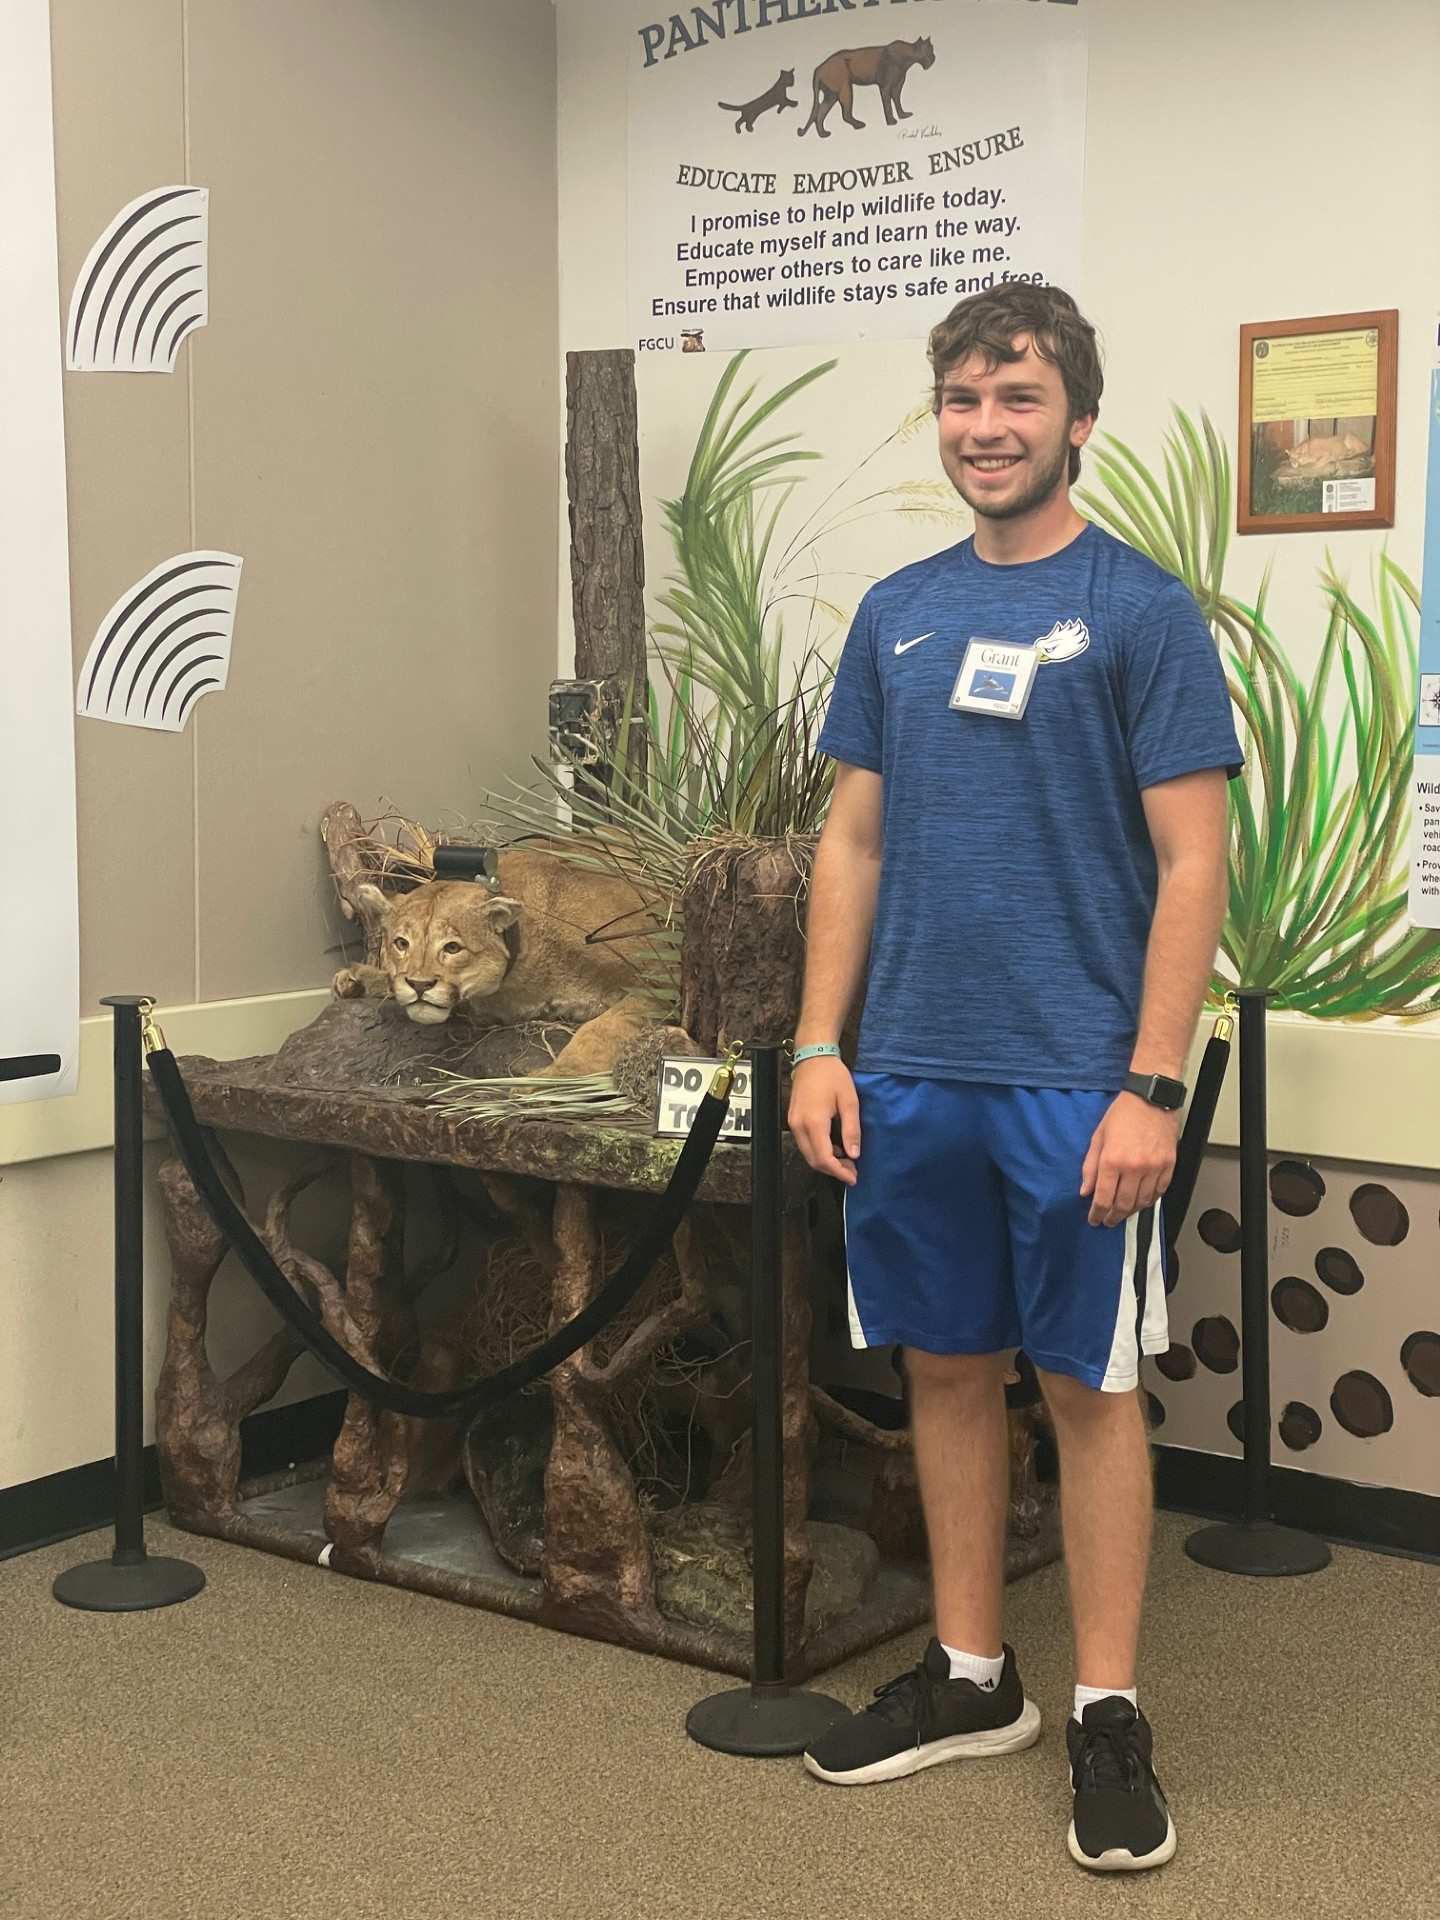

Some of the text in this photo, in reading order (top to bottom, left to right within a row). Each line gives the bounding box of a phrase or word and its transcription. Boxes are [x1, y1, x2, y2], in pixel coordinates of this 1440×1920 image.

[676, 164, 777, 194] EDUCATE
[792, 161, 914, 194] EMPOWER
[928, 126, 1024, 175] ENSURE
[691, 187, 1006, 237] I promise to help wildlife today.
[677, 216, 1021, 261] Educate myself and learn the way.
[685, 246, 1011, 289] Empower others to care like me.
[652, 298, 717, 316] Ensure
[723, 291, 760, 311] that
[766, 286, 836, 307] wildlife
[843, 283, 898, 305] stays
[904, 277, 948, 298] safe
[954, 272, 994, 293] and
[639, 337, 674, 351] FGCU
[981, 648, 1020, 667] Grant
[664, 1066, 703, 1093] DO
[668, 1103, 751, 1132] TCH
